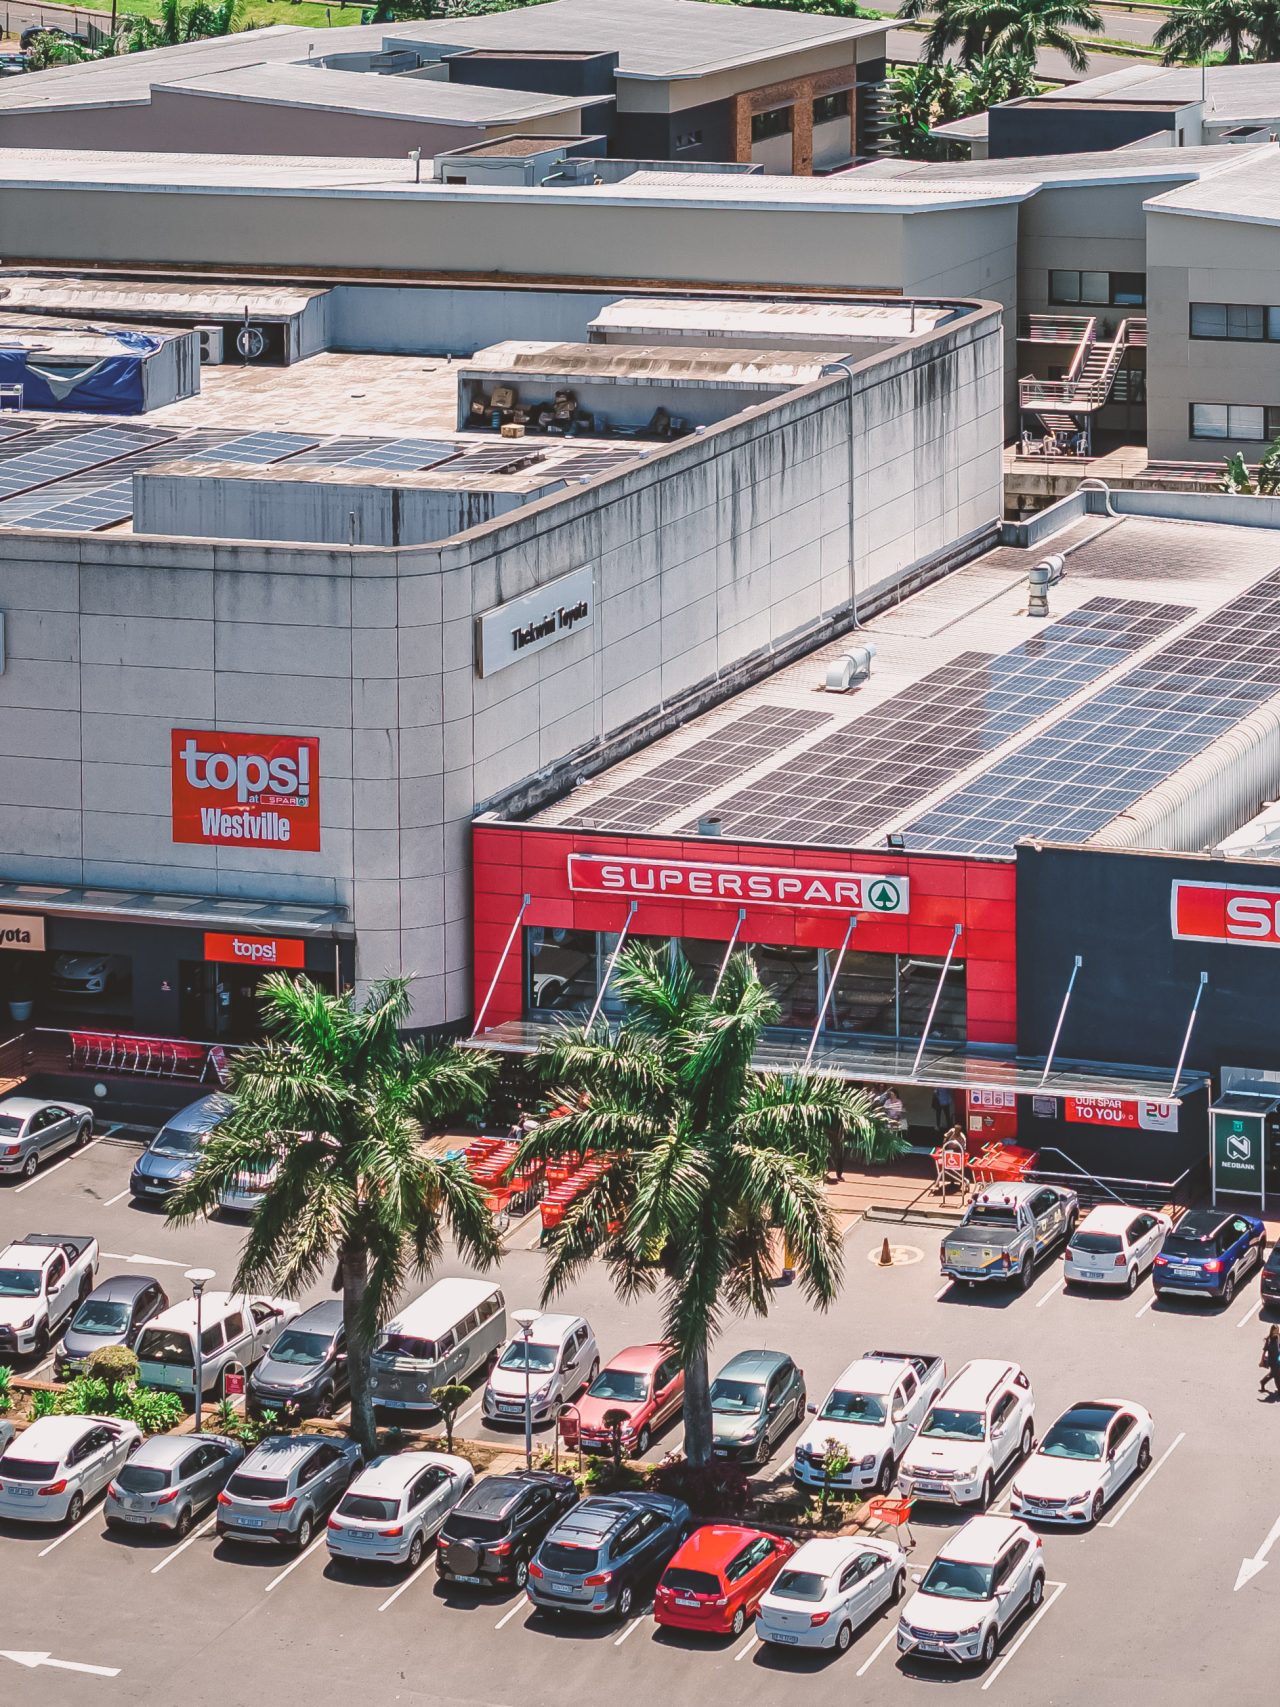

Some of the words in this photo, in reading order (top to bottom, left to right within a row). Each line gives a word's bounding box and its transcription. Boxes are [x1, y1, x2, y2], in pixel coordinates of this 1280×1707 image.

[510, 611, 555, 651] Thekwini
[556, 600, 588, 629] Toyota
[179, 739, 310, 803] tops!
[249, 794, 259, 804] at
[269, 795, 297, 806] SPAR
[200, 807, 290, 842] Westville
[601, 865, 860, 904] SUPERSPAR
[232, 938, 277, 961] tops!
[1075, 1097, 1096, 1107] OUR
[1097, 1099, 1122, 1109] SPAR
[1075, 1106, 1094, 1119] TO
[1095, 1108, 1122, 1121] YOU
[1221, 1161, 1255, 1170] NEDBANK
